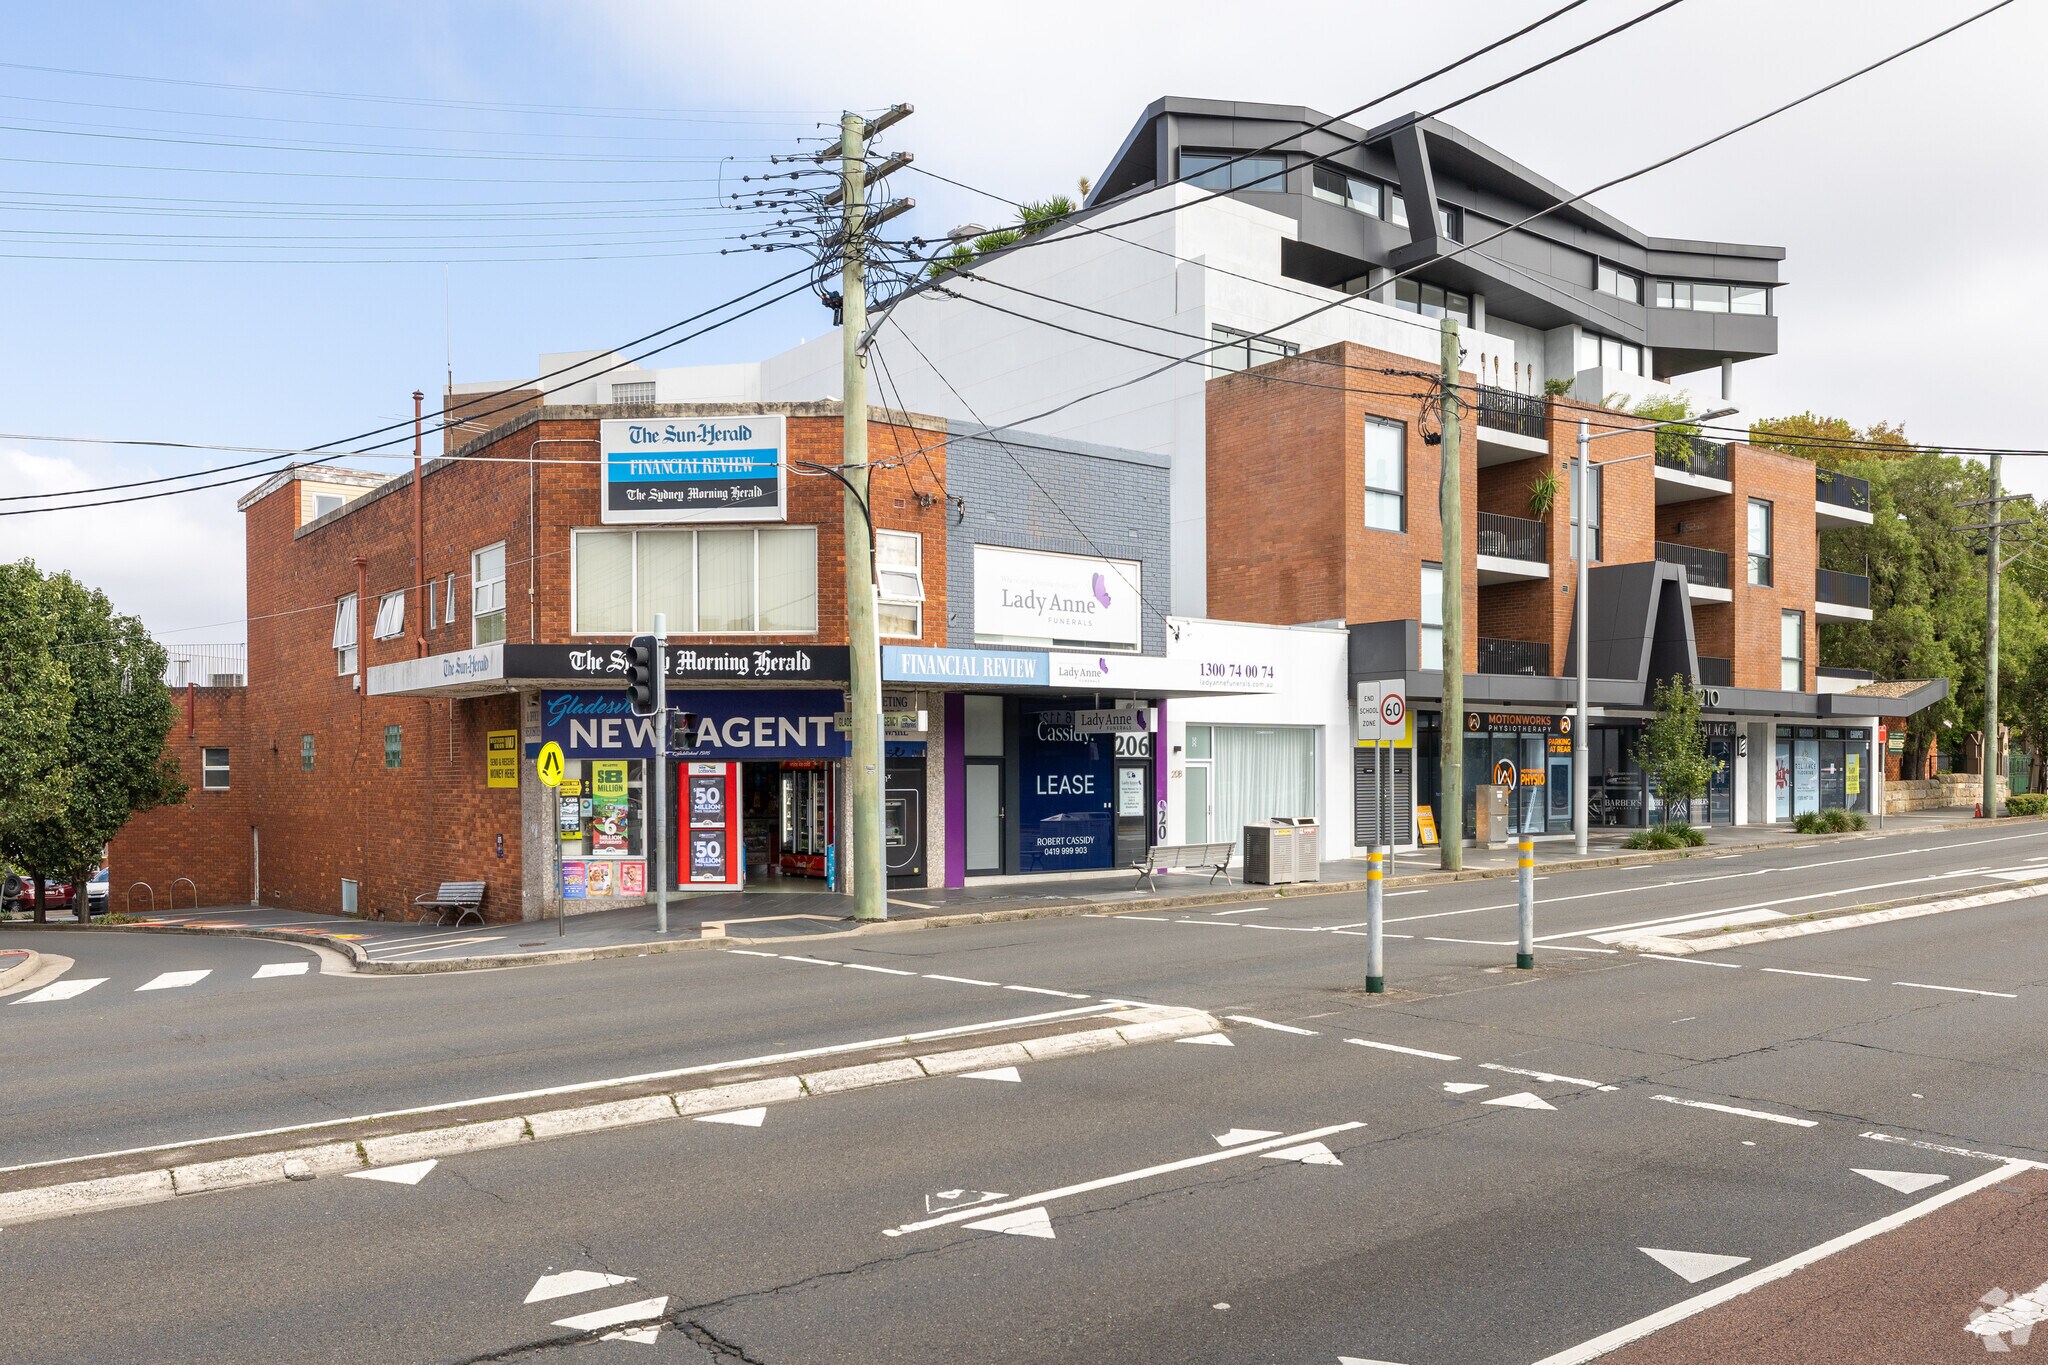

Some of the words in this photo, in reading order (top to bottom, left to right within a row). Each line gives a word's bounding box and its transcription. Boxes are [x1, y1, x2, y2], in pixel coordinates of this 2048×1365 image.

[629, 425, 659, 444] The
[662, 423, 752, 445] Sun-Herald
[630, 458, 700, 475] FINANCIAL
[703, 456, 755, 474] REVIEW
[626, 488, 646, 502] The
[648, 488, 684, 502] Sydney
[687, 487, 729, 501] Morning
[731, 485, 763, 501] Herald
[1002, 589, 1047, 616] Lady
[1049, 593, 1096, 614] Anne
[1048, 617, 1093, 627] FUNERALS
[443, 658, 454, 677] The
[456, 654, 489, 678] Sun-Herald
[569, 650, 603, 674] The
[675, 650, 749, 675] Morning
[752, 650, 811, 676] Herald
[901, 653, 979, 676] FINANCIAL
[983, 657, 1037, 678] REVIEW
[1059, 667, 1079, 679] Lady
[1080, 668, 1102, 678] Anne
[1200, 663, 1225, 676] 1300
[1230, 664, 1242, 677] 74
[1245, 665, 1258, 678] 00
[1262, 666, 1274, 679] 74
[1200, 678, 1274, 688] ladyannefunerals.com.au
[882, 696, 908, 708] ETING
[1360, 707, 1379, 715] SCHOOL
[1385, 702, 1401, 717] 60
[839, 717, 852, 727] GLADE
[884, 717, 899, 727] GENCY
[1081, 713, 1105, 730] Lady
[1105, 714, 1132, 725] Anne
[1488, 714, 1551, 726] MOTIONWORKS
[570, 717, 834, 749] NEWAGENT
[1116, 735, 1149, 756] 206
[1557, 745, 1572, 753] REAR
[490, 758, 498, 766] SEND
[490, 769, 503, 779] MONEY
[505, 768, 515, 778] HERE
[1521, 773, 1546, 786] PHYSIO
[597, 784, 623, 792] MILLION
[1036, 774, 1095, 795] LEASE
[693, 787, 720, 805] $50
[695, 803, 720, 811] MILLION
[1605, 799, 1642, 807] BARBER'S
[1037, 836, 1065, 846] ROBERT
[1066, 835, 1095, 845] CASSIDY
[693, 840, 720, 858] $50
[1044, 847, 1060, 856] 0419
[1061, 846, 1074, 855] 999
[1075, 846, 1088, 854] 903
